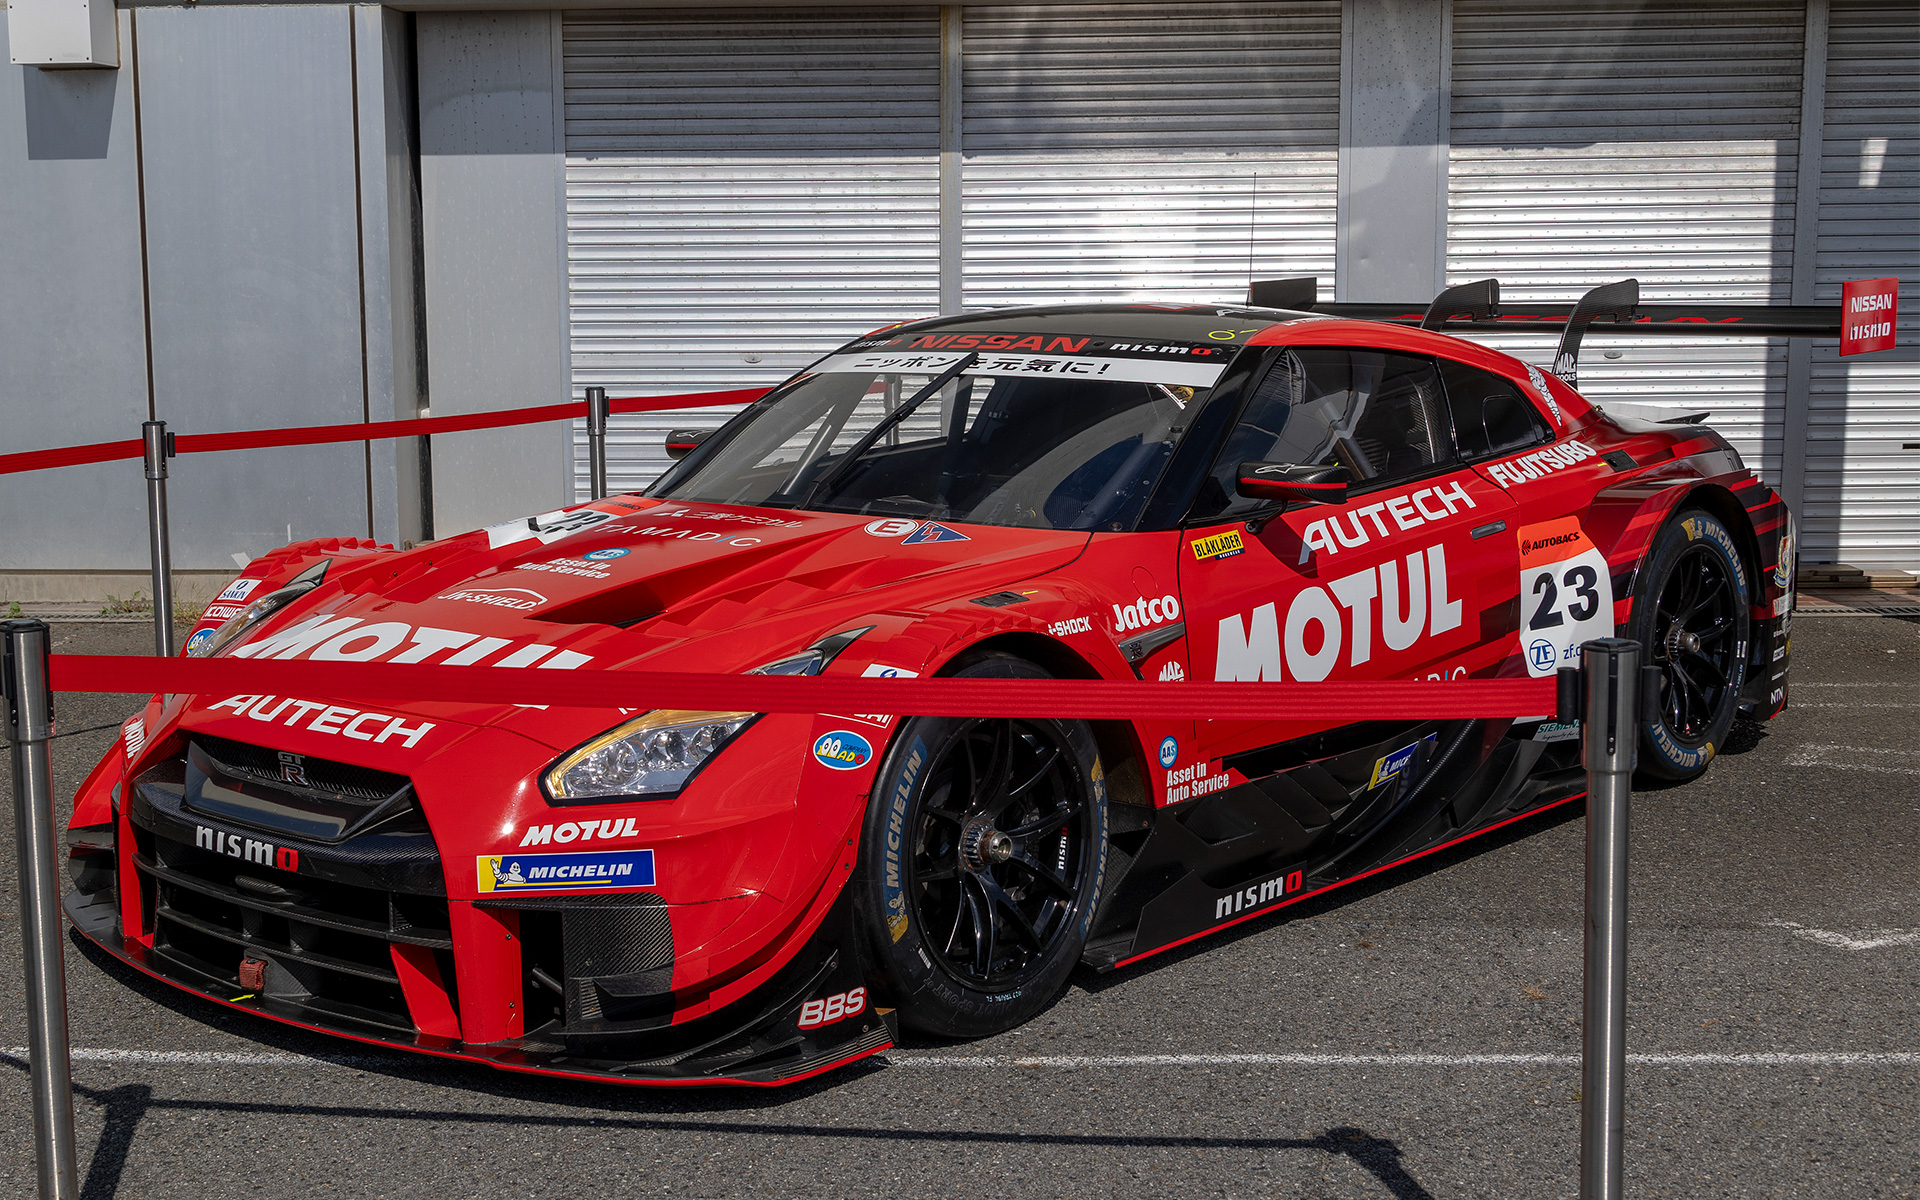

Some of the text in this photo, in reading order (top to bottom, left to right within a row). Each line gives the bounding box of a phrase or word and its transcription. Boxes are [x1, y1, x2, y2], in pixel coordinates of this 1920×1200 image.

[1851, 293, 1892, 313] NISSAN
[908, 335, 1090, 352] NISSAN
[1110, 343, 1212, 356] nismo
[1556, 353, 1576, 375] MAC
[1487, 439, 1598, 489] FUJITSUBO
[1298, 481, 1477, 565] AUTECH
[1195, 534, 1241, 557] BLÅKLÄDER
[1532, 532, 1580, 550] AUTOBACS
[1704, 521, 1746, 586] MICHELIN
[1214, 543, 1462, 682] MOTUL
[1529, 565, 1600, 631] 23
[1112, 595, 1180, 632] Jatco
[1531, 645, 1553, 667] ZF
[1770, 686, 1784, 705] NTN
[206, 694, 437, 749] AUTECH
[278, 751, 306, 765] GT
[1162, 745, 1175, 759] AAS
[1166, 762, 1207, 787] Asset in
[1166, 773, 1229, 805] Auto Service
[519, 818, 640, 847] MOTUL
[886, 749, 922, 888] MICHELIN
[196, 824, 299, 872] nismo
[1057, 827, 1069, 870] nismo
[528, 863, 633, 879] MICHELIN
[1215, 869, 1303, 919] nismo
[798, 987, 866, 1028] BBS
